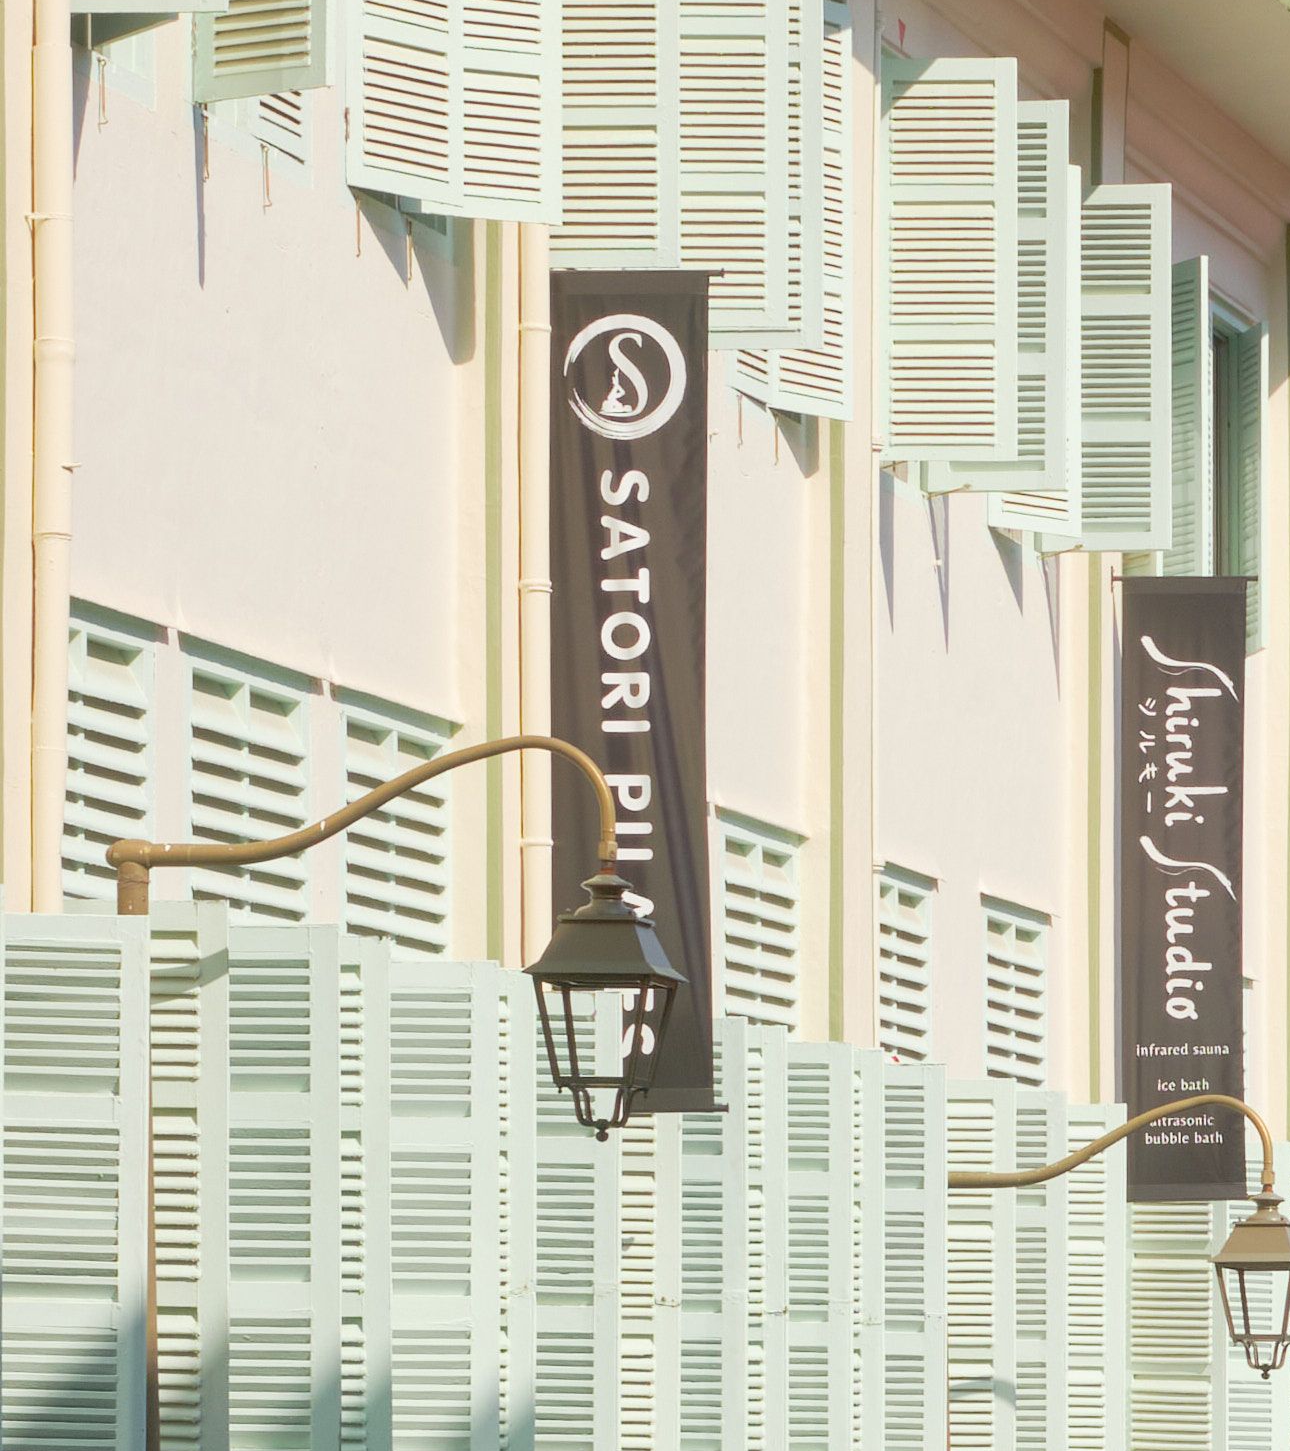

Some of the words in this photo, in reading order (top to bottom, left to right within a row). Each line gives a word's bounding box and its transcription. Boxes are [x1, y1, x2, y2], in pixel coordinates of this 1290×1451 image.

[600, 469, 651, 733] SATORI
[1138, 697, 1157, 813] シルキー
[1140, 635, 1239, 828] Shiruki
[1139, 835, 1236, 1020] Studio
[1136, 1043, 1188, 1057] infrared
[1192, 1044, 1230, 1055] sauna
[1157, 1079, 1176, 1091] ice
[1180, 1078, 1209, 1091] bath
[1145, 1132, 1189, 1145] bubble
[1194, 1131, 1223, 1144] bath
